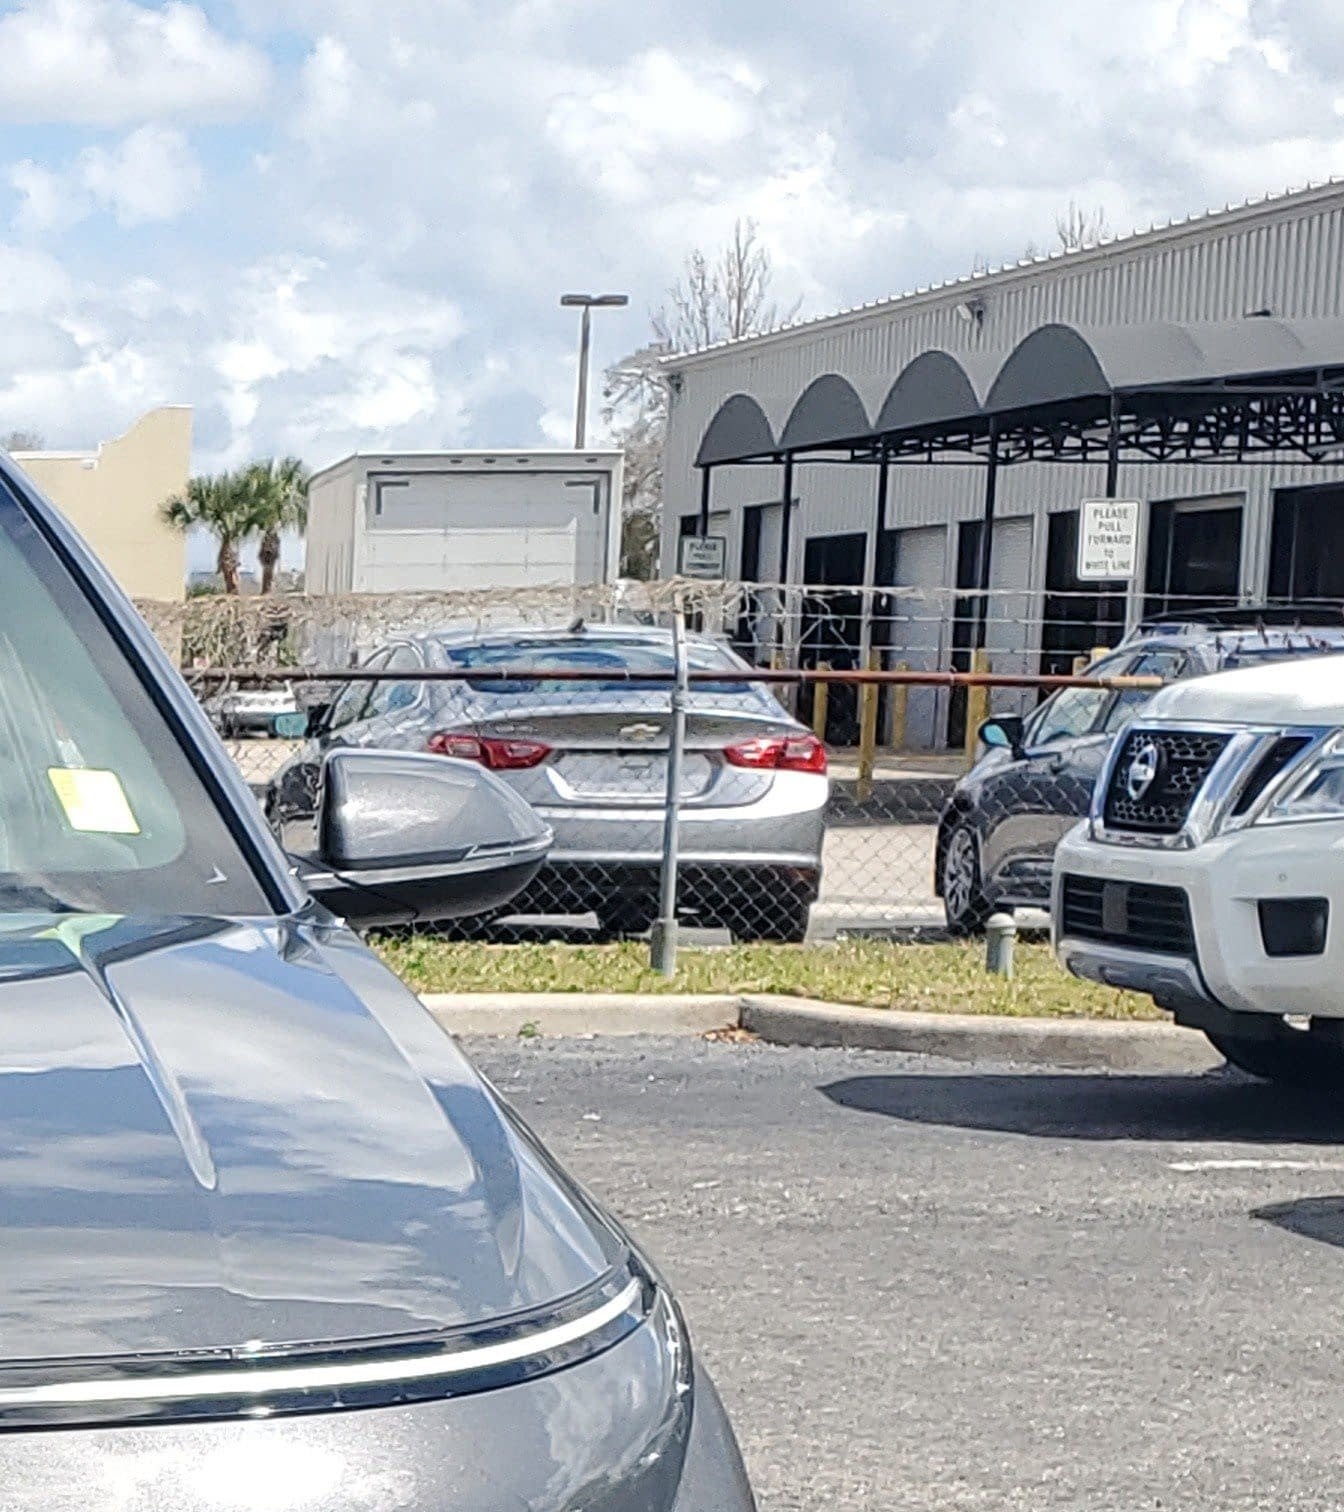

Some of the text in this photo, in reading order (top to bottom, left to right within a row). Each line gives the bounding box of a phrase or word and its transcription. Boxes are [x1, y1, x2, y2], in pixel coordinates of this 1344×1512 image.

[1093, 508, 1128, 519] PLEASE
[1098, 521, 1121, 532] PULL
[1088, 534, 1131, 546] FORWARD
